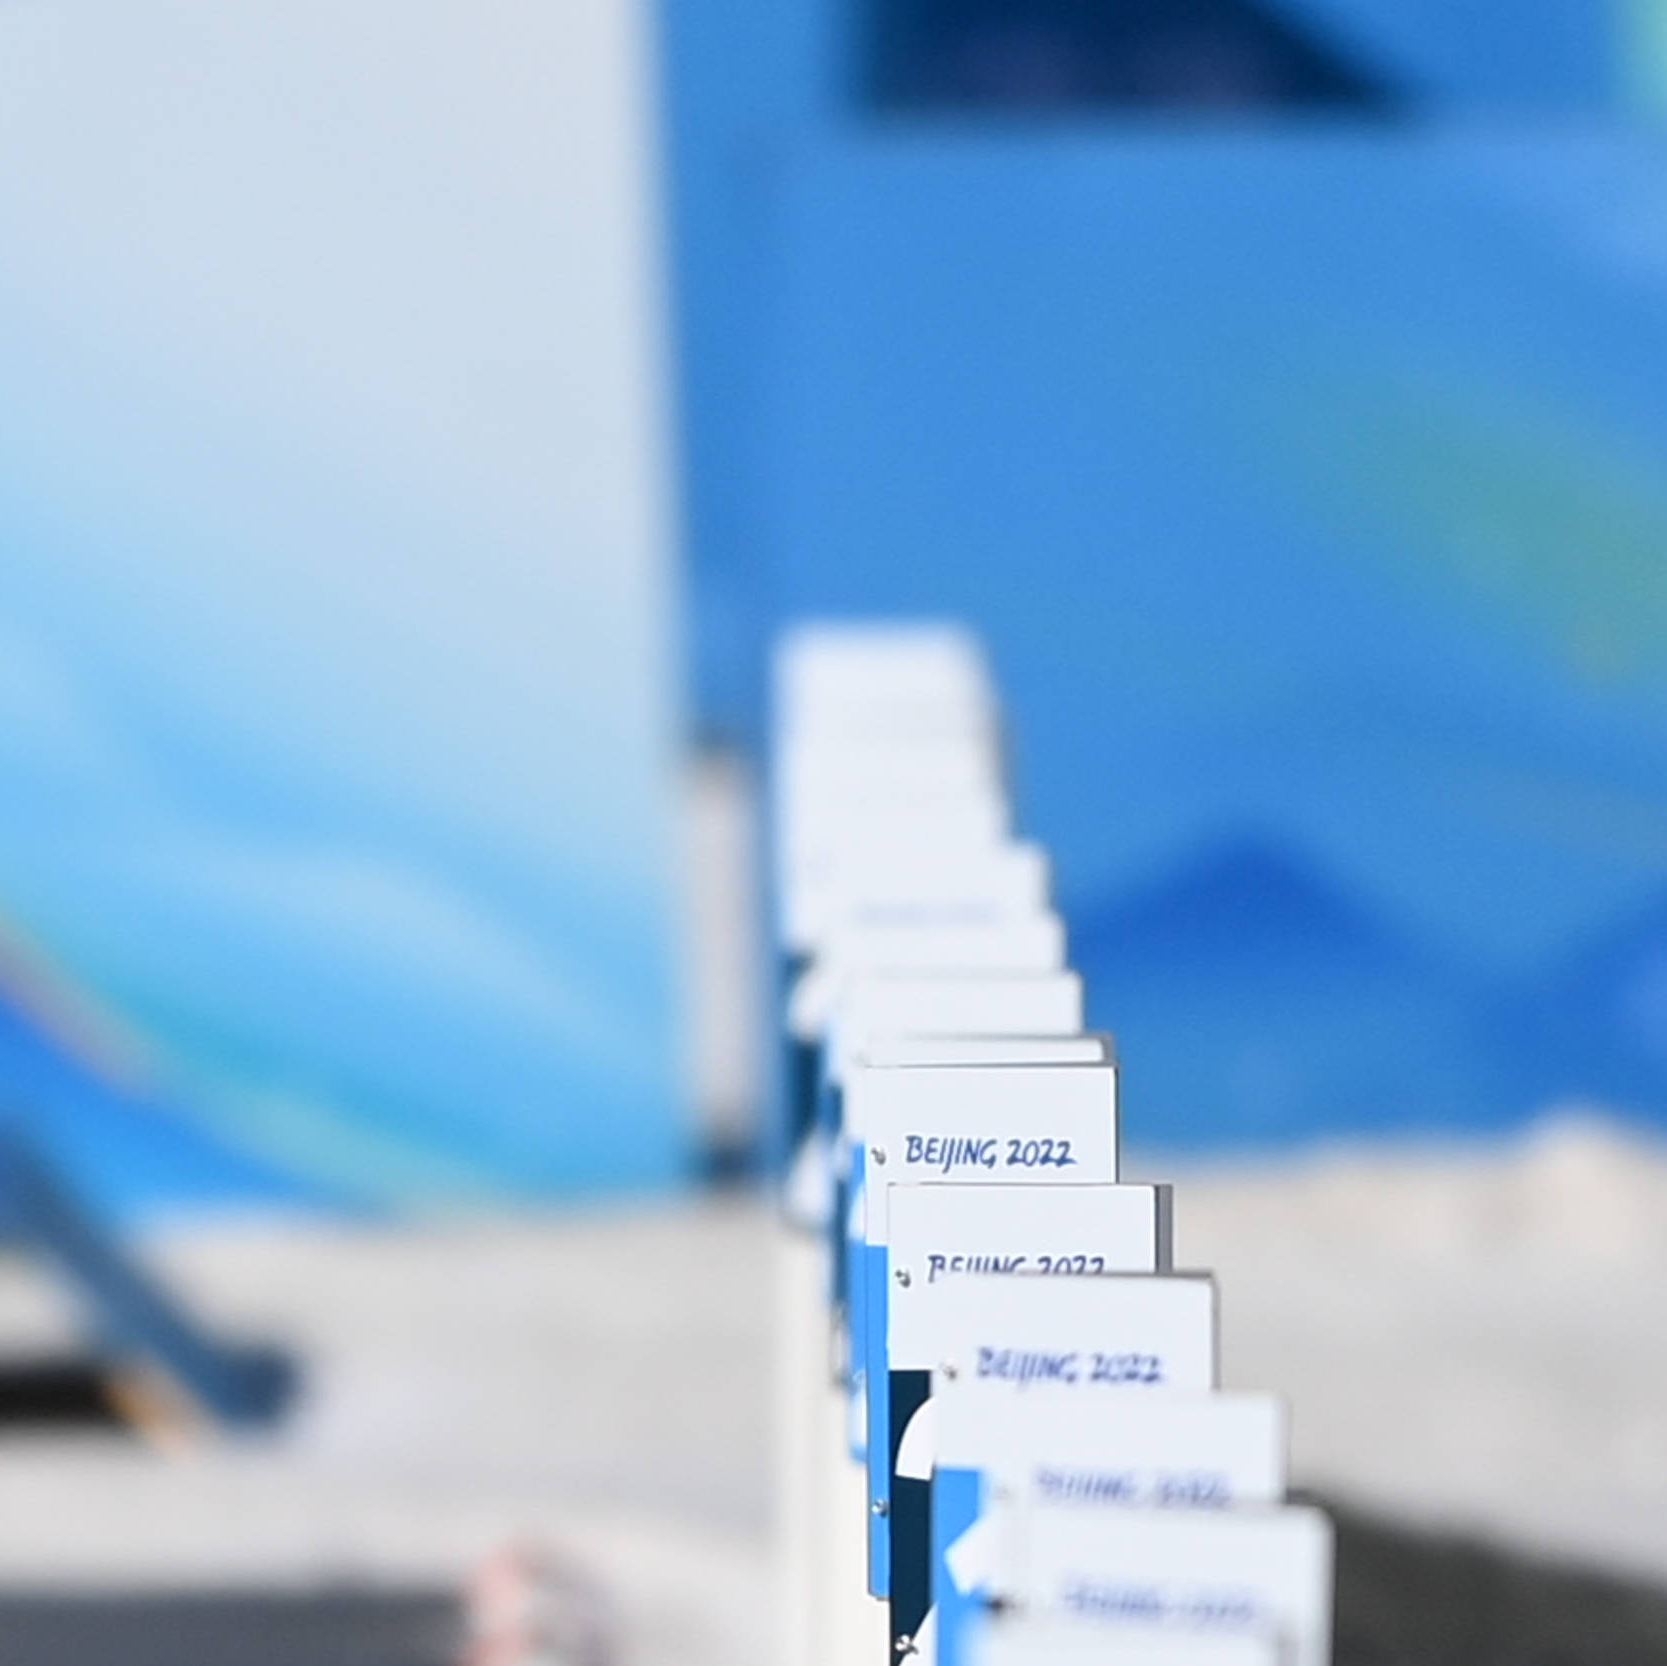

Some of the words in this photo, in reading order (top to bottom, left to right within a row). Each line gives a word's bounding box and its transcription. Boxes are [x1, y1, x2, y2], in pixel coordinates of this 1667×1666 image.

[905, 1135, 998, 1174] BEIJING
[1006, 1139, 1077, 1167] 2022
[1090, 1352, 1164, 1383] 2022
